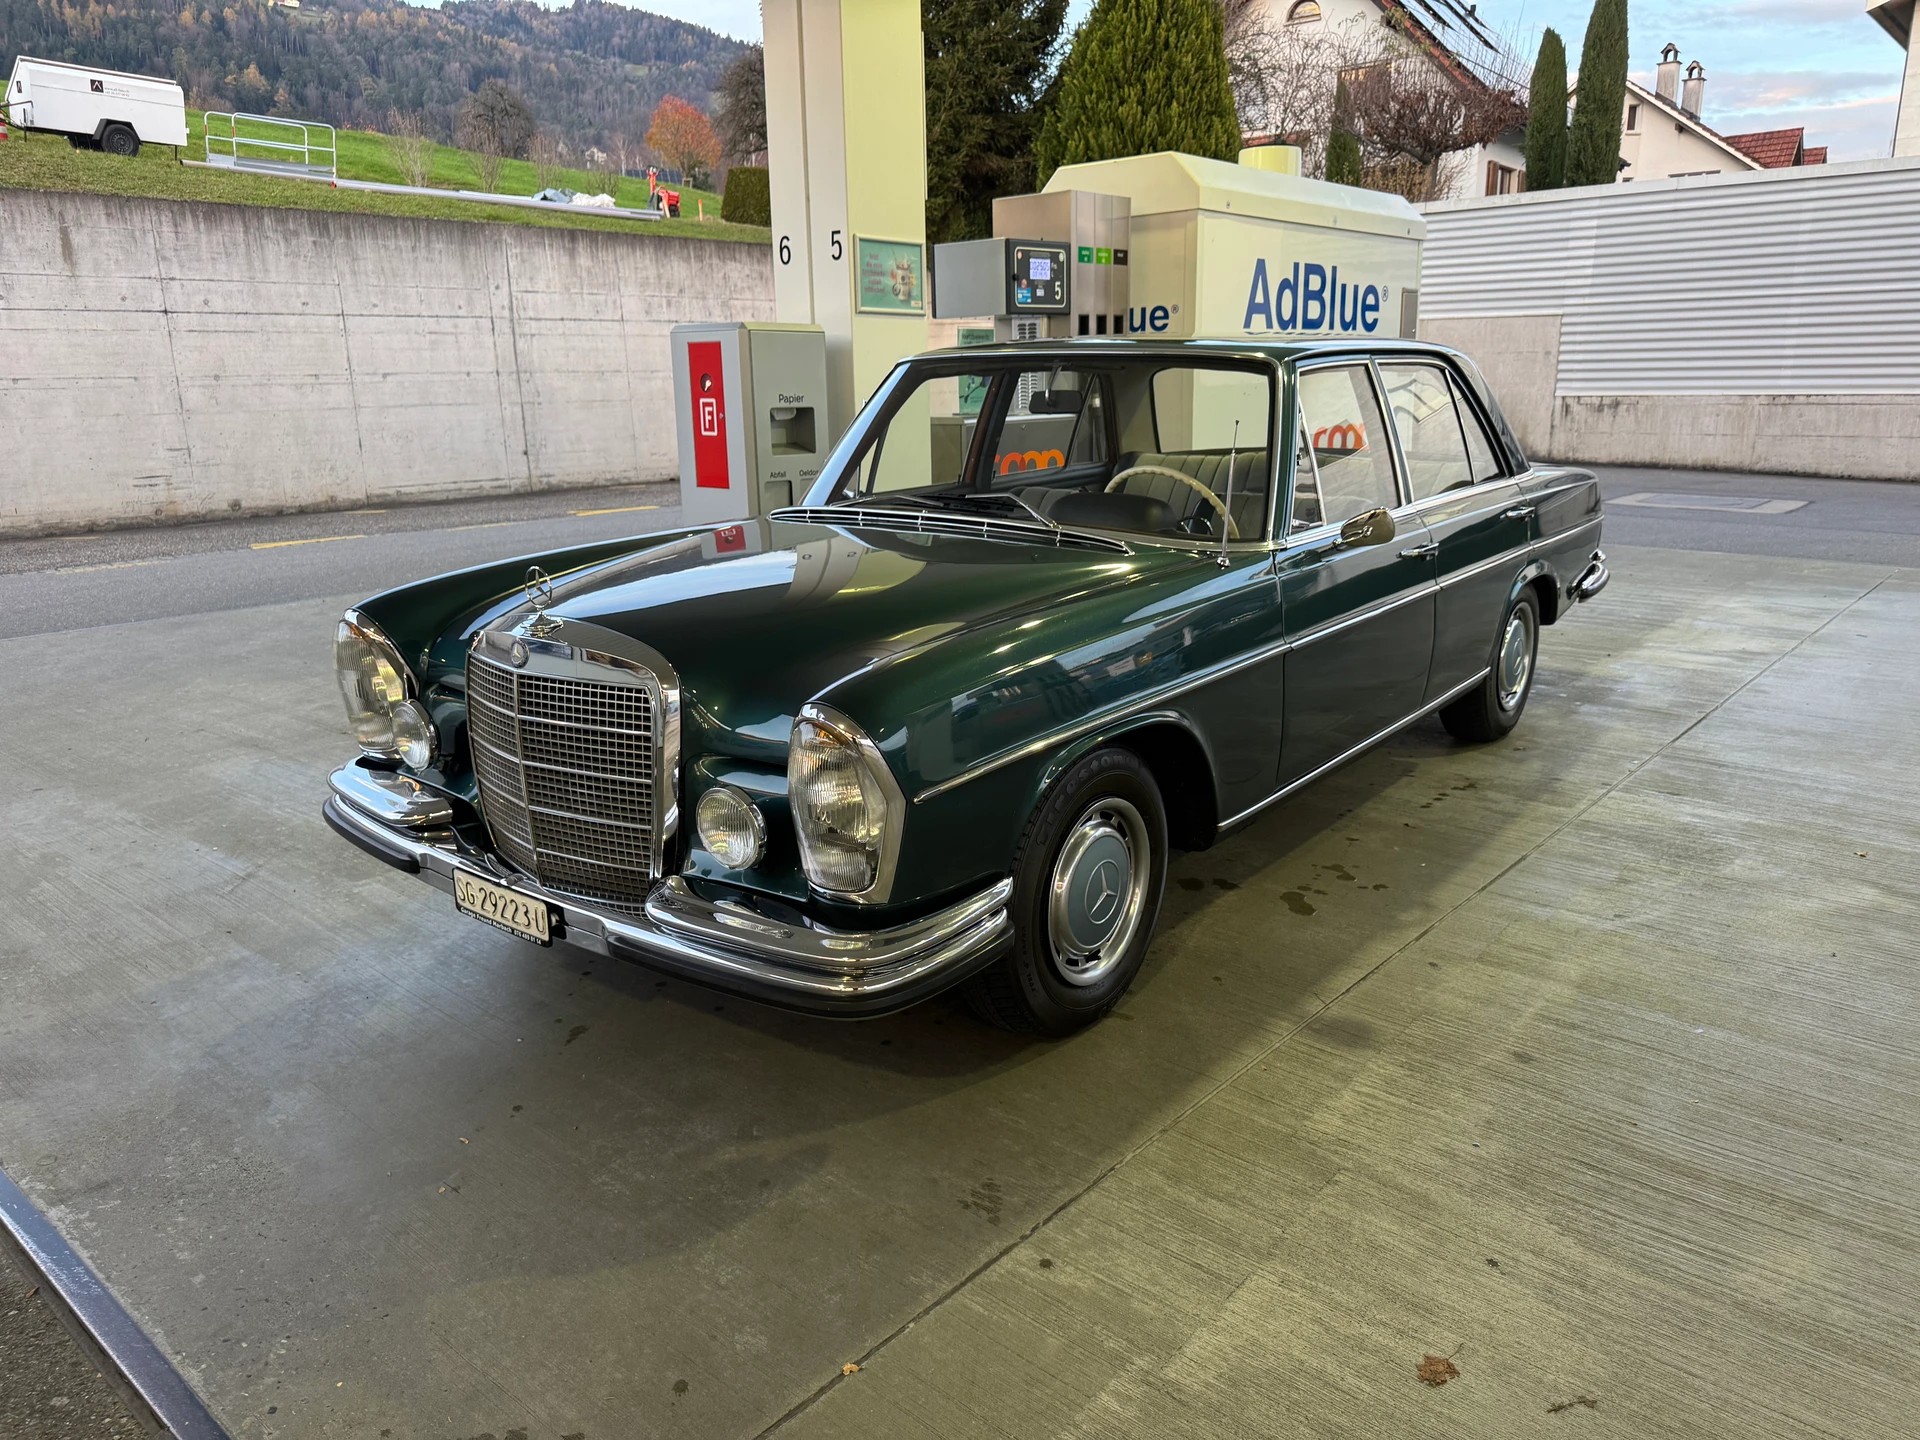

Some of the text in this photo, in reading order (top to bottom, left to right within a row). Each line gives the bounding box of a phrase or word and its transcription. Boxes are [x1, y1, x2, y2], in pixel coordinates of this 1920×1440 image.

[779, 235, 791, 265] 6
[831, 230, 842, 261] 5
[1054, 281, 1062, 300] 5
[778, 393, 805, 405] Papier
[704, 406, 713, 429] F
[769, 471, 787, 479] Abfall
[460, 906, 476, 919] Garage
